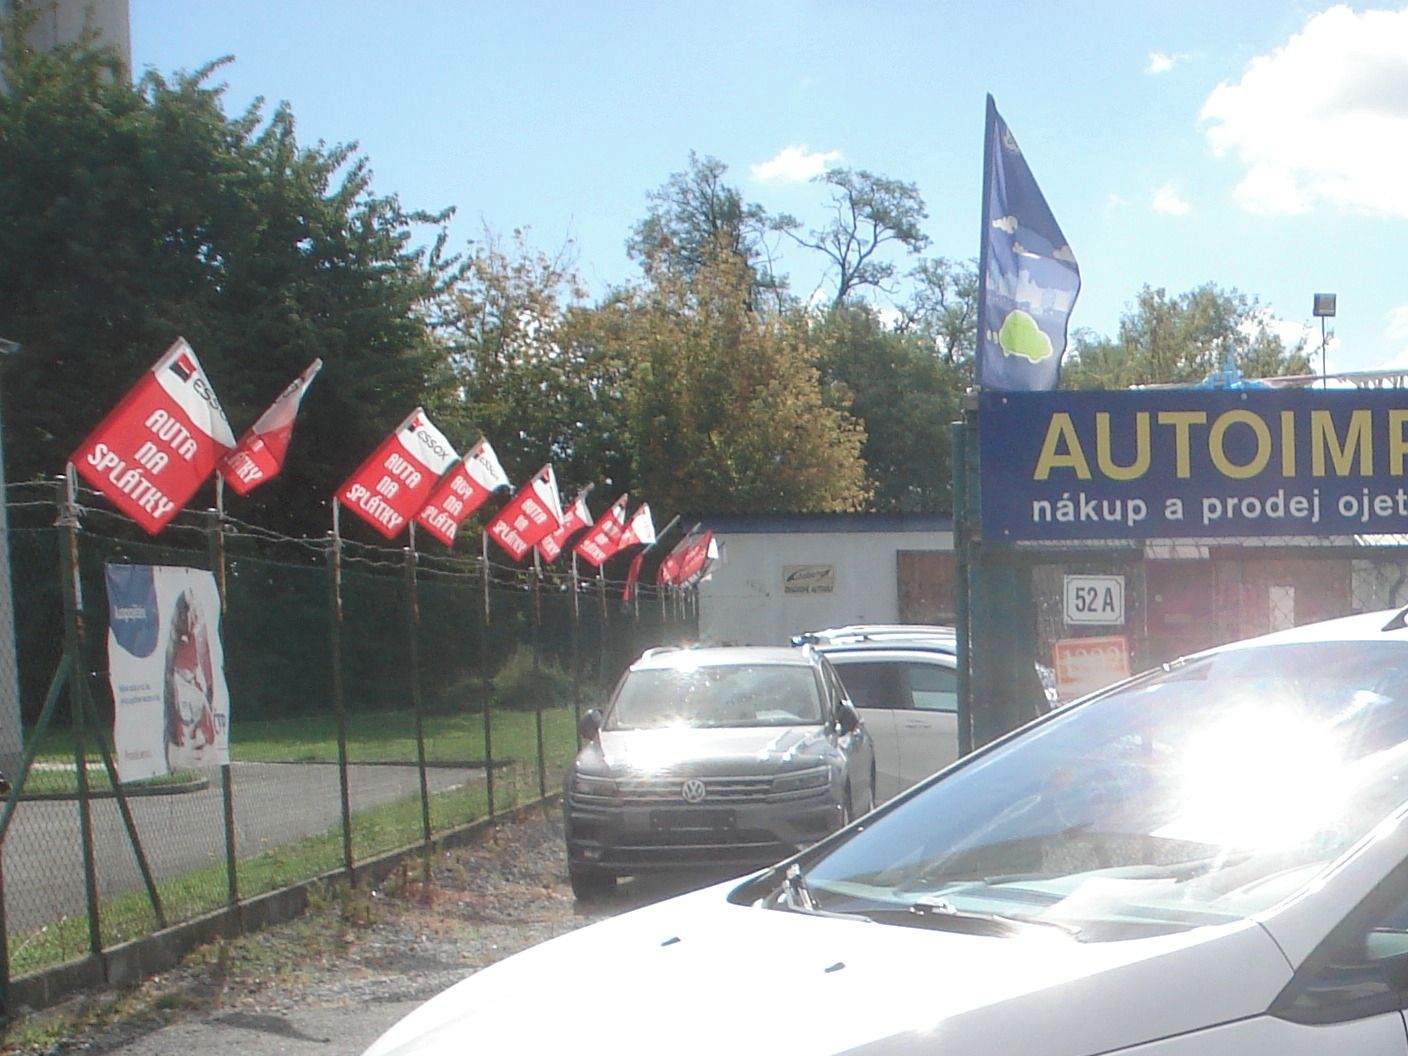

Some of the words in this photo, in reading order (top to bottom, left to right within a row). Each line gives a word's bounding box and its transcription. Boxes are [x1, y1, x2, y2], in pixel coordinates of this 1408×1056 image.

[145, 409, 198, 462] AUTA
[417, 430, 449, 461] ESSOX
[134, 441, 169, 475] NA
[384, 453, 422, 489] AUTA
[87, 443, 175, 518] SPLÁTKY
[376, 476, 399, 498] NA
[346, 483, 403, 529] SPLÁTKY
[1033, 491, 1147, 526] nákup
[1164, 499, 1184, 521] a
[1202, 489, 1320, 525] prodej
